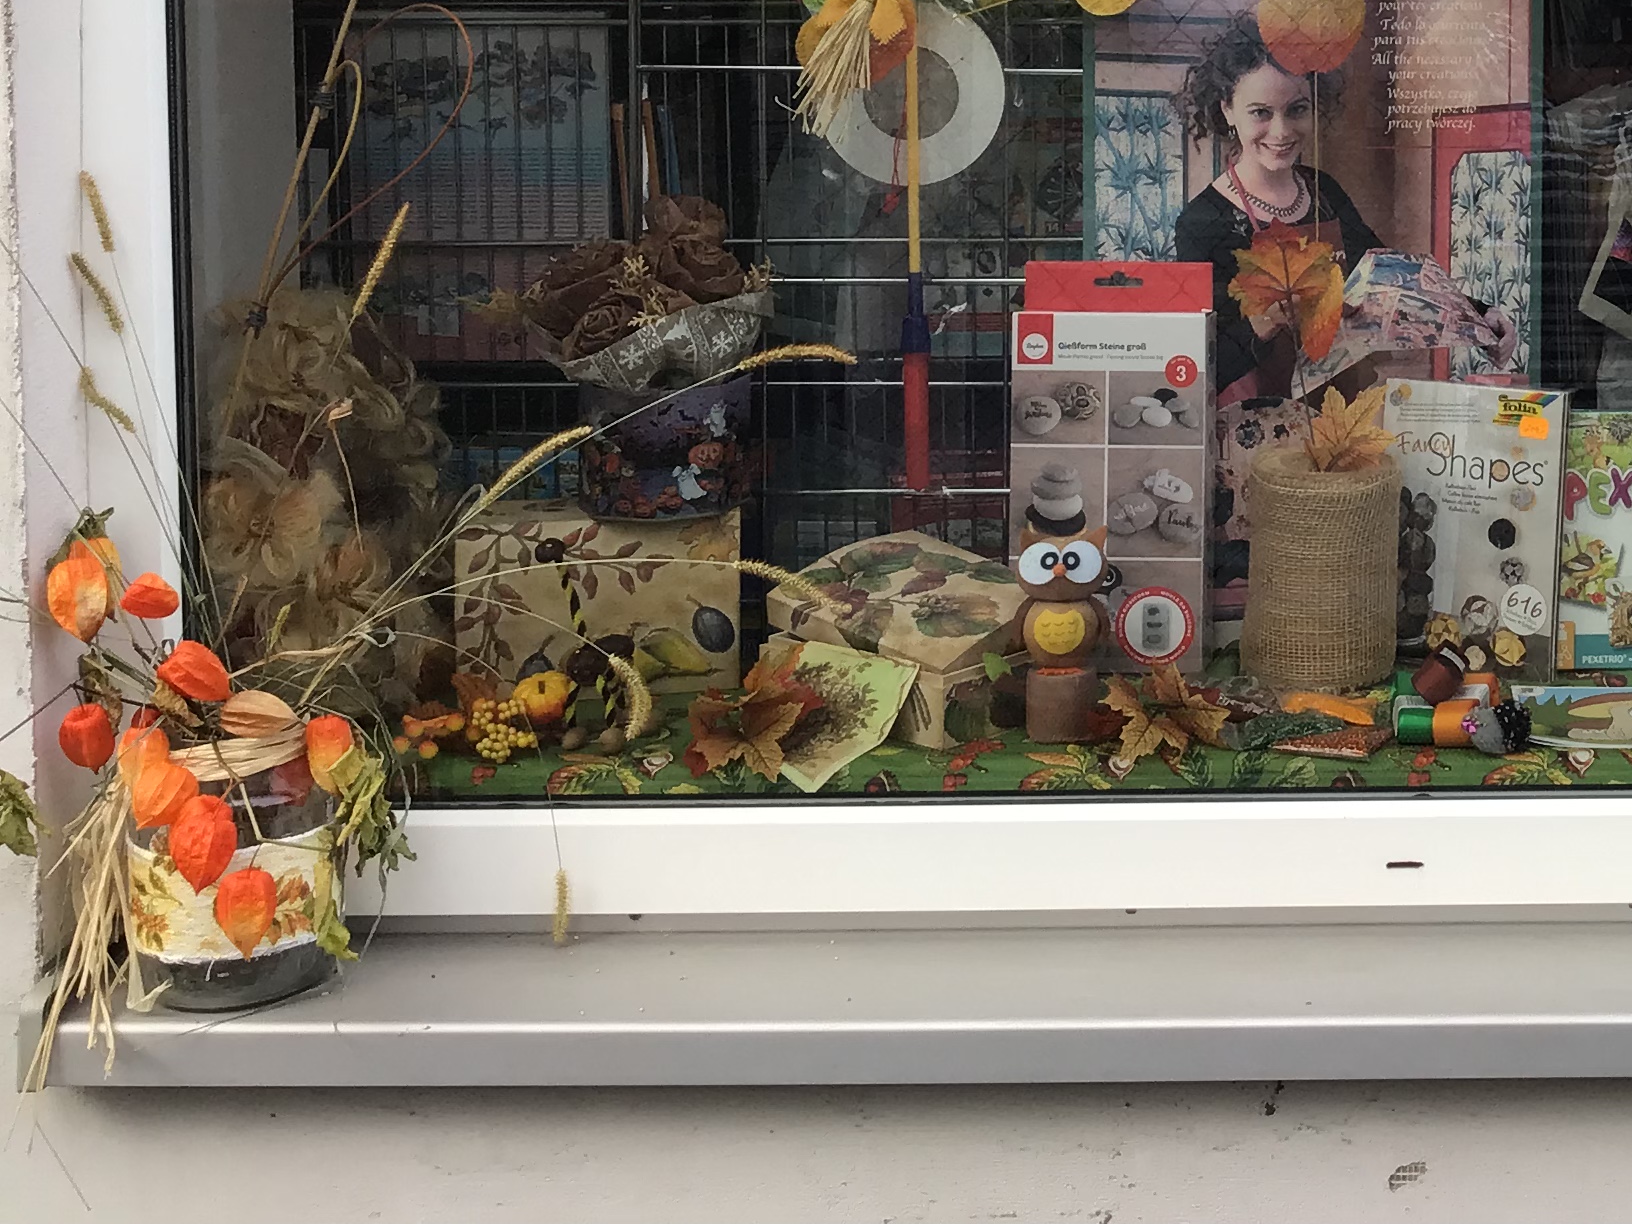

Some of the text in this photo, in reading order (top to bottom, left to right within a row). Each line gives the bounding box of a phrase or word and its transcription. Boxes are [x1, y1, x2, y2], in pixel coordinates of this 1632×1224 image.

[1372, 52, 1391, 65] All
[1385, 119, 1423, 134] pracy
[1099, 340, 1125, 351] Steine
[1127, 341, 1147, 353] groß
[1175, 366, 1187, 382] 3
[1502, 402, 1538, 415] folia
[1426, 432, 1544, 489] Shapes
[1507, 591, 1542, 618] 616
